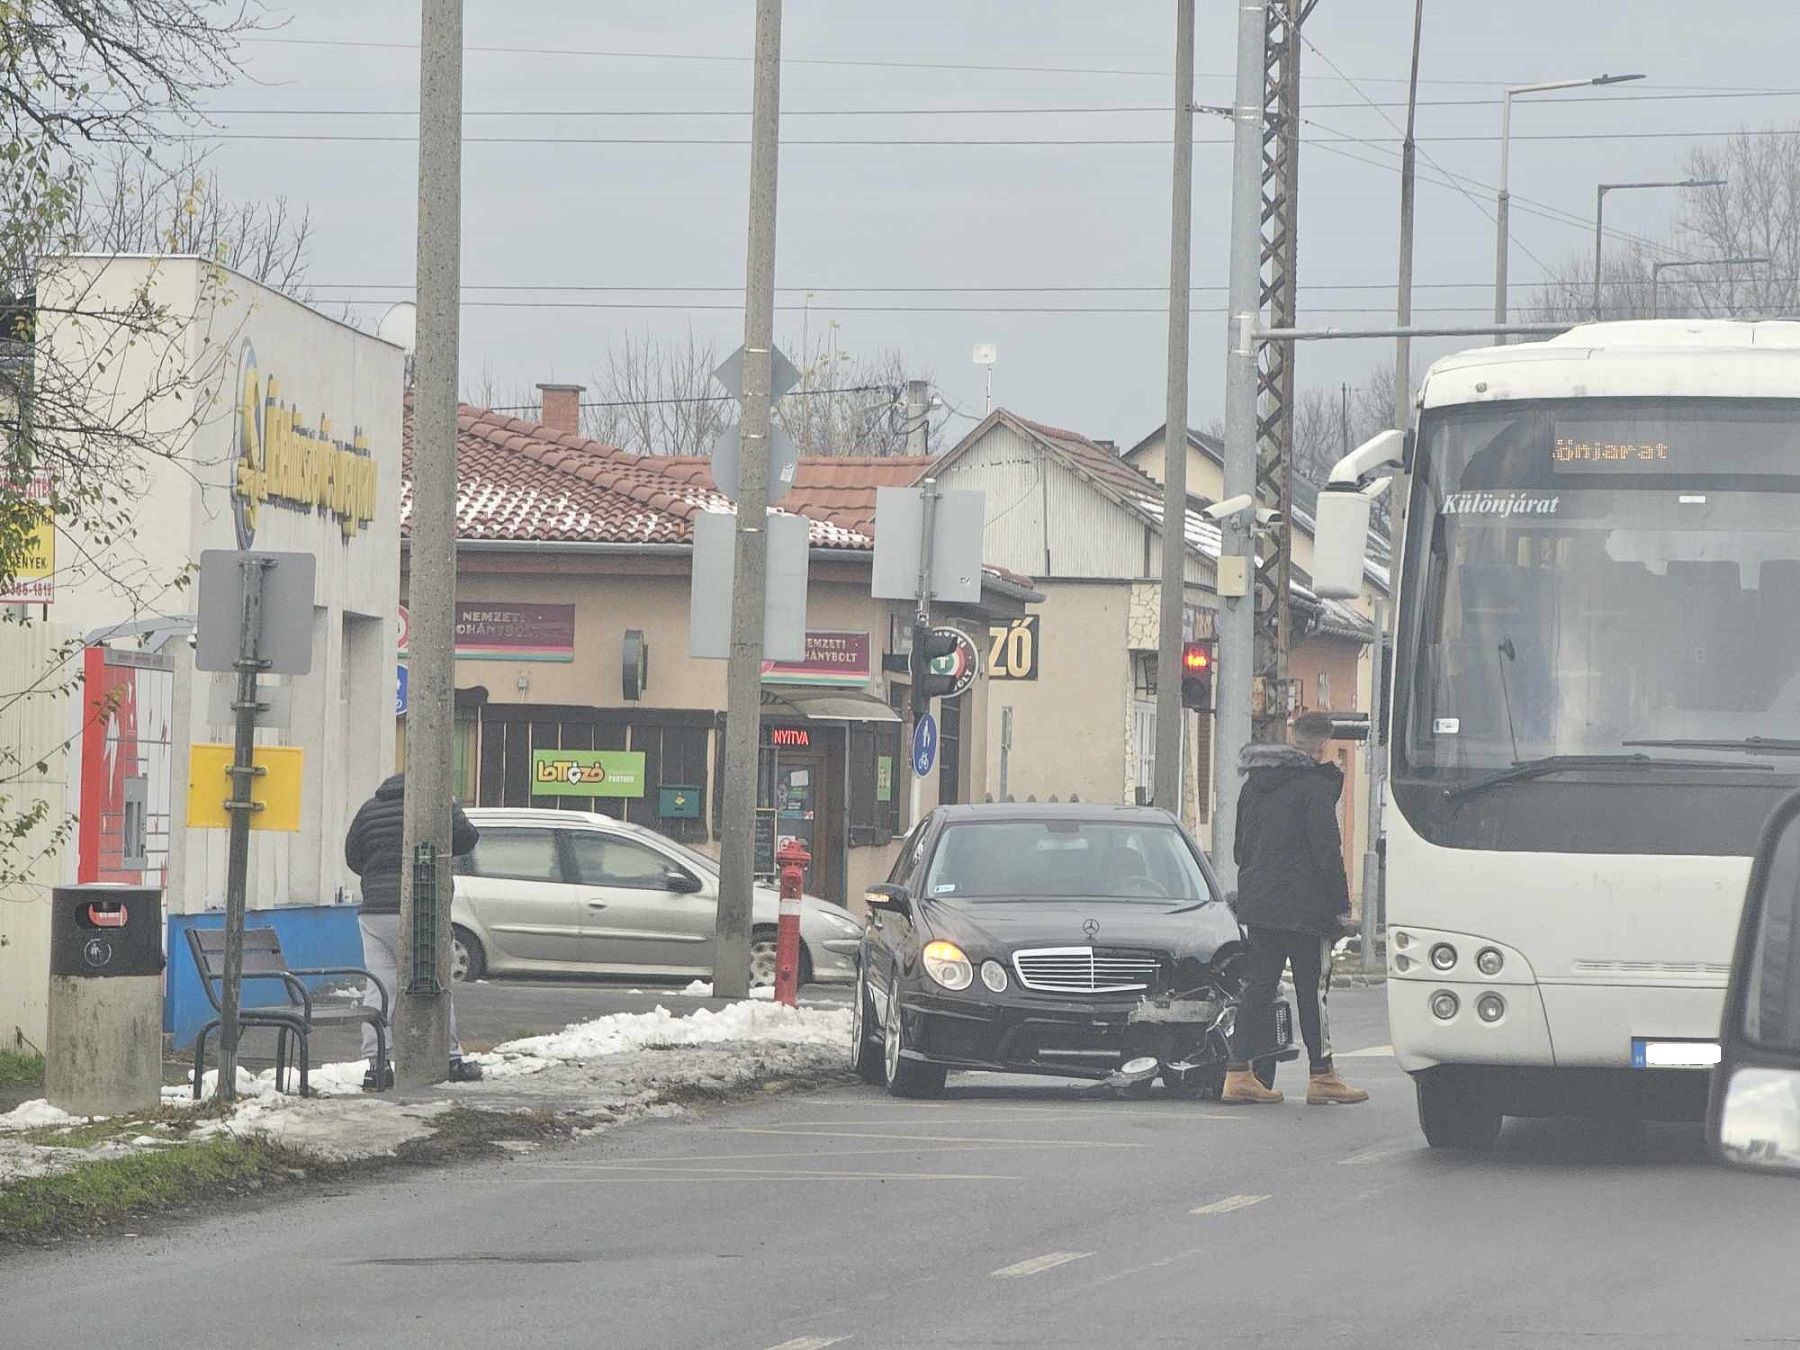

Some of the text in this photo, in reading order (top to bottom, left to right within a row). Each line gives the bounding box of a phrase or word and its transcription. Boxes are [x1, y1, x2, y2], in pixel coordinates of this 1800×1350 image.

[1552, 438, 1668, 462] önjarat
[1441, 493, 1560, 518] Különjárat
[806, 637, 847, 649] EMZETI
[805, 648, 858, 663] HÁNYBOLT
[773, 729, 810, 746] NYITVA
